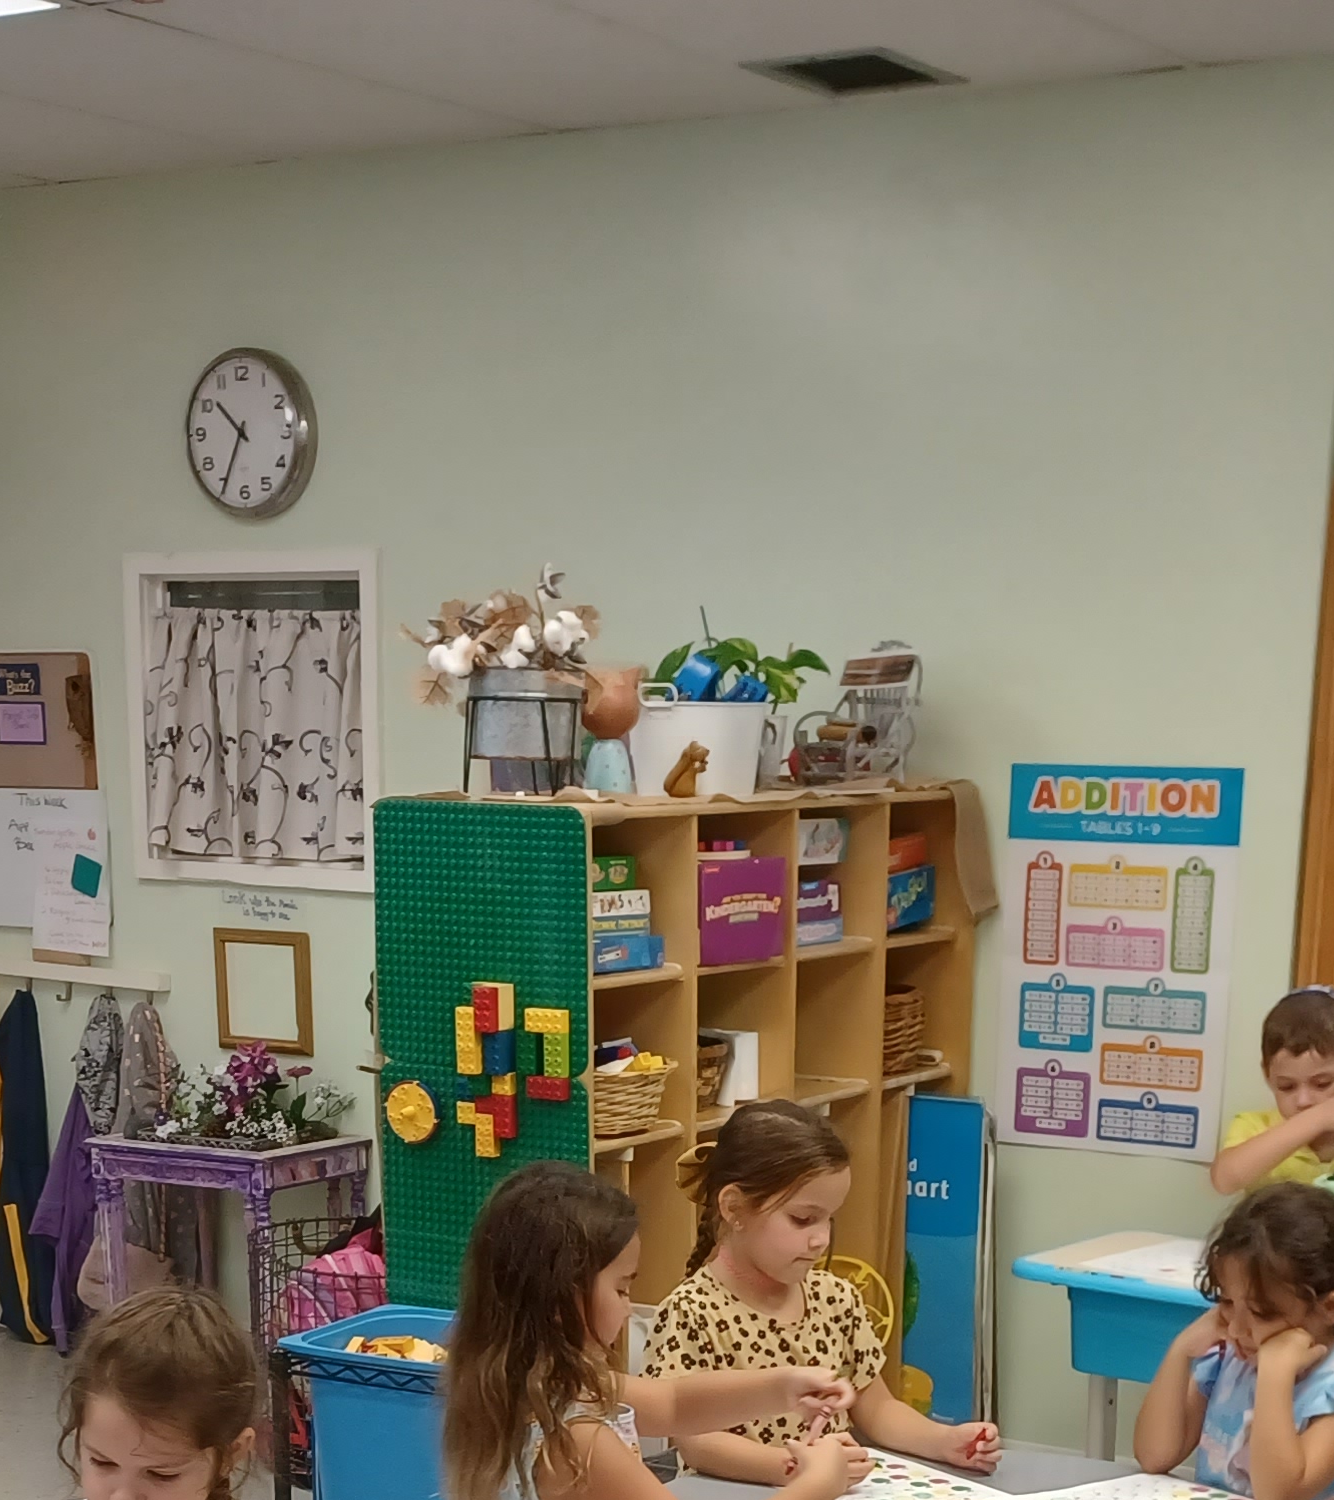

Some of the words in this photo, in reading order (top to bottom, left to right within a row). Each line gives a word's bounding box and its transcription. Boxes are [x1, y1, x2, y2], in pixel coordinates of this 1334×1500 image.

[234, 366, 249, 381] 12
[217, 374, 226, 390] 11
[201, 399, 214, 413] 10
[274, 394, 285, 410] 2
[195, 427, 207, 442] 9
[280, 424, 292, 439] 3
[202, 457, 215, 471] 8
[275, 454, 286, 468] 4
[219, 477, 228, 495] 7
[260, 477, 272, 491] 5
[239, 485, 251, 500] 6
[1033, 779, 1217, 813] ADDITION
[1080, 820, 1132, 835] TABLES
